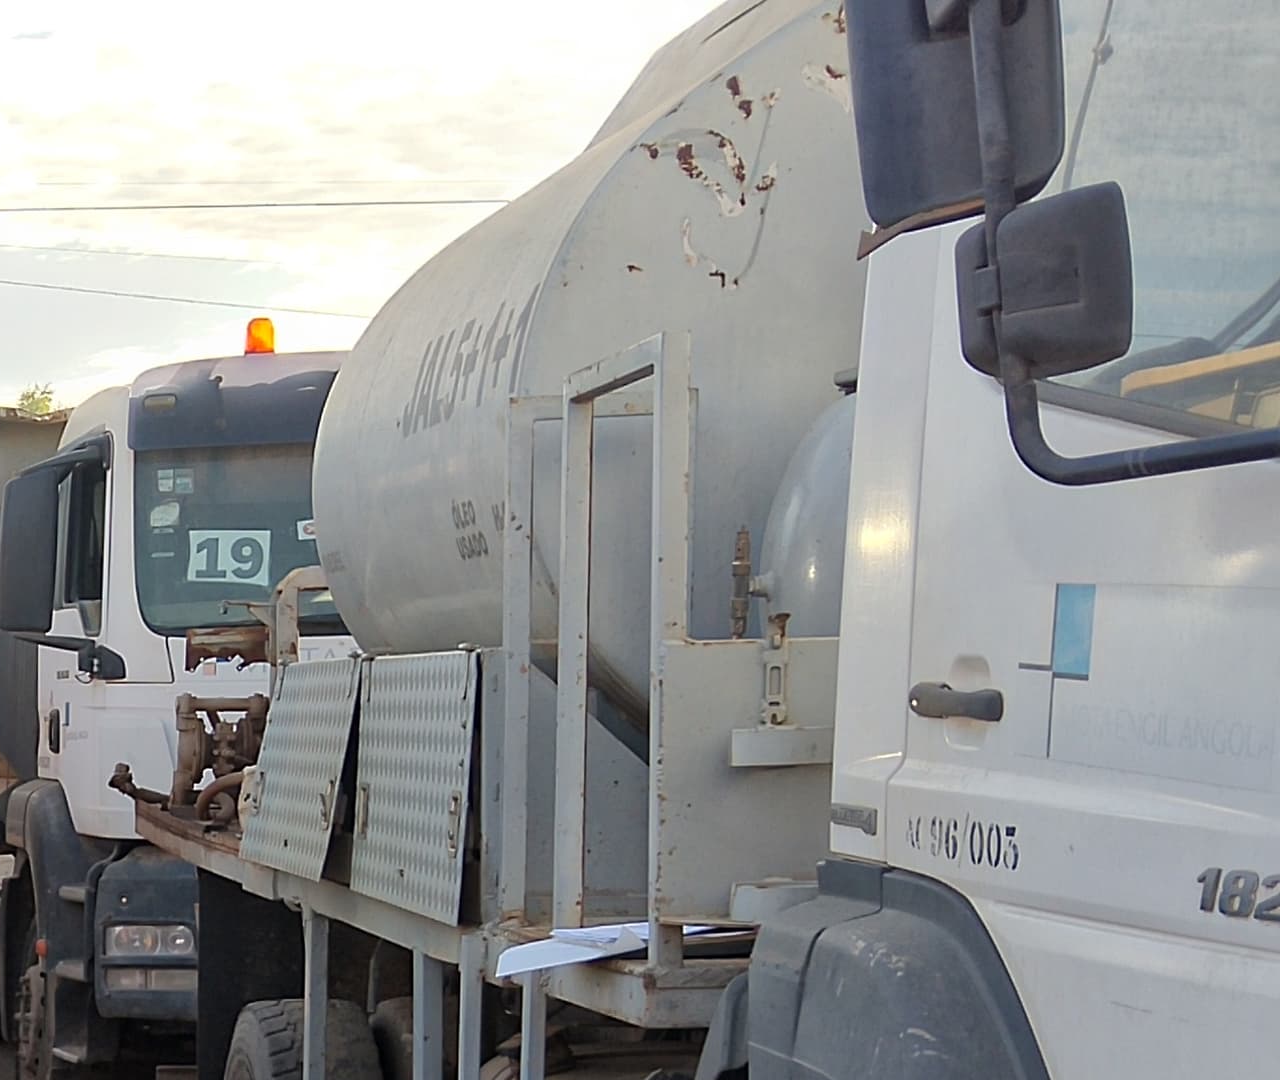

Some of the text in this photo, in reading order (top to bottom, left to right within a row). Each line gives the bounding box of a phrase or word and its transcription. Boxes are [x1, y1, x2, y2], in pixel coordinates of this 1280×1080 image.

[195, 536, 265, 580] 19
[456, 530, 489, 561] USADO
[1197, 866, 1280, 922] 182
